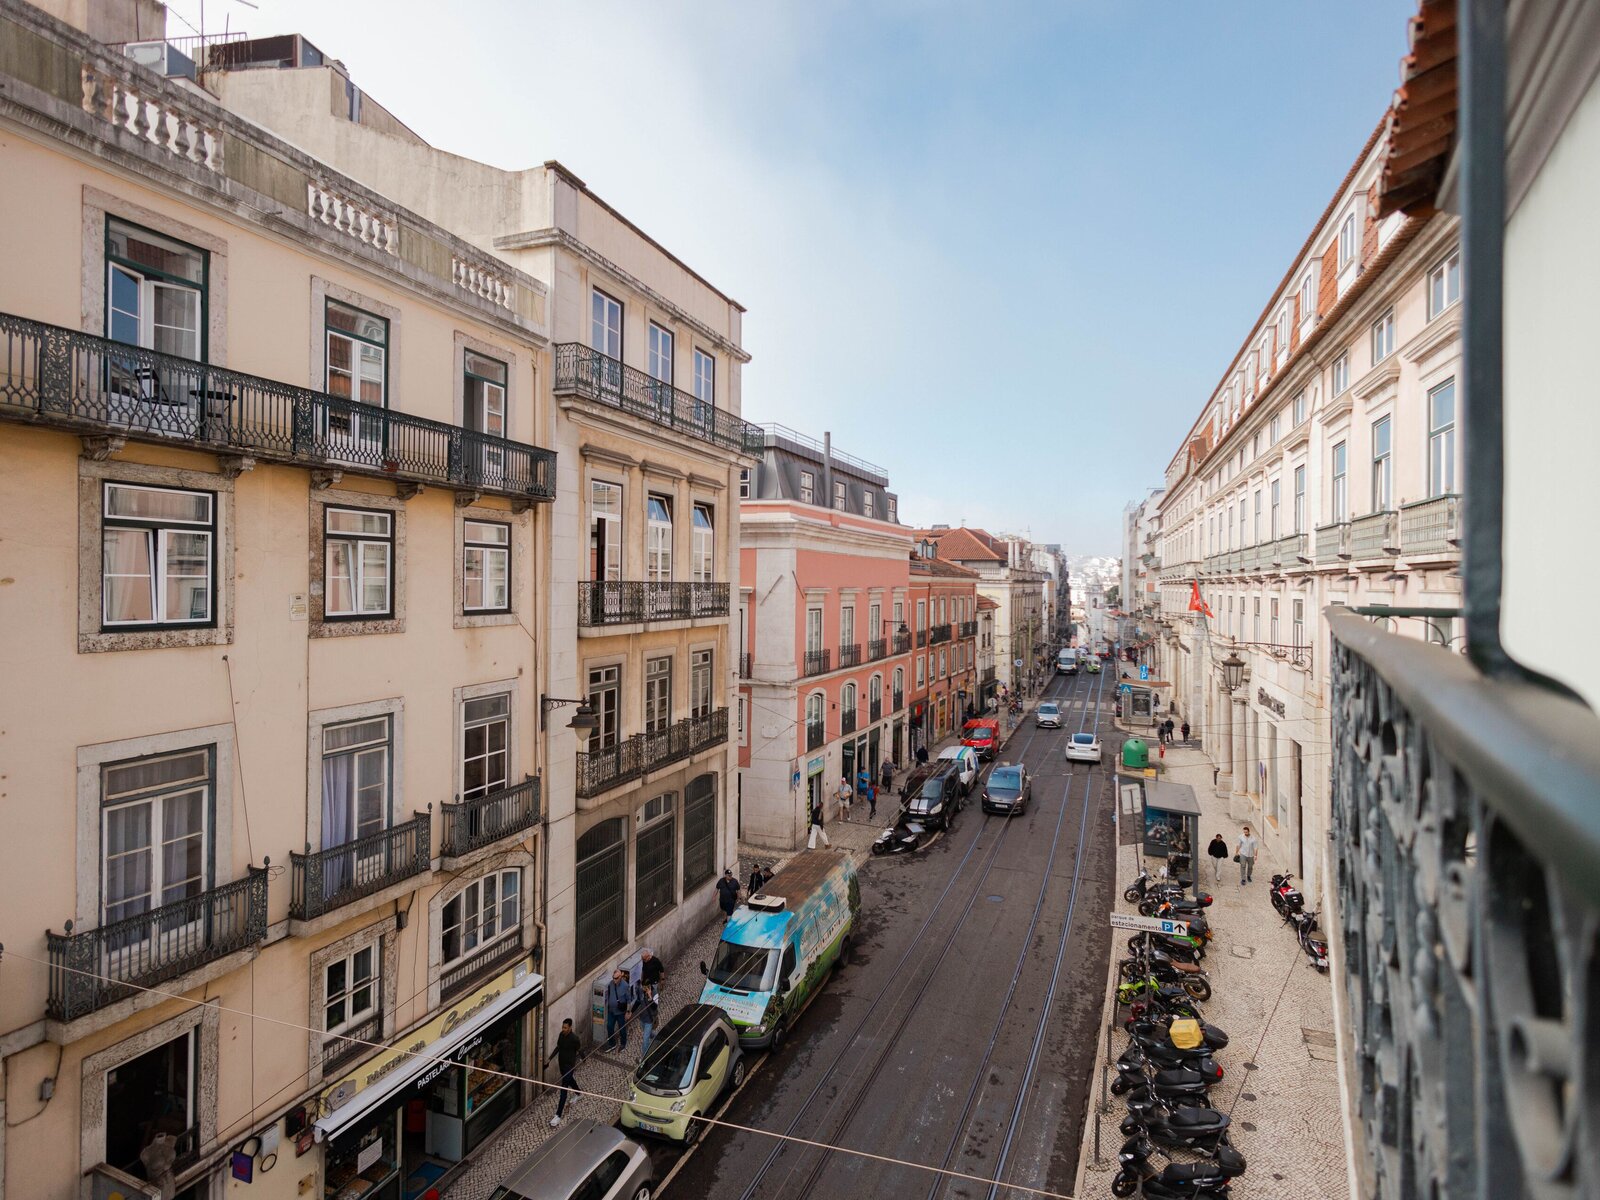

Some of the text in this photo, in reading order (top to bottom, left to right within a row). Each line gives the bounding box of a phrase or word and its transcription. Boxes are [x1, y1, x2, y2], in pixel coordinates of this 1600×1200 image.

[1112, 920, 1170, 931] estacionamento P
[417, 1057, 453, 1090] PASTELARIA
